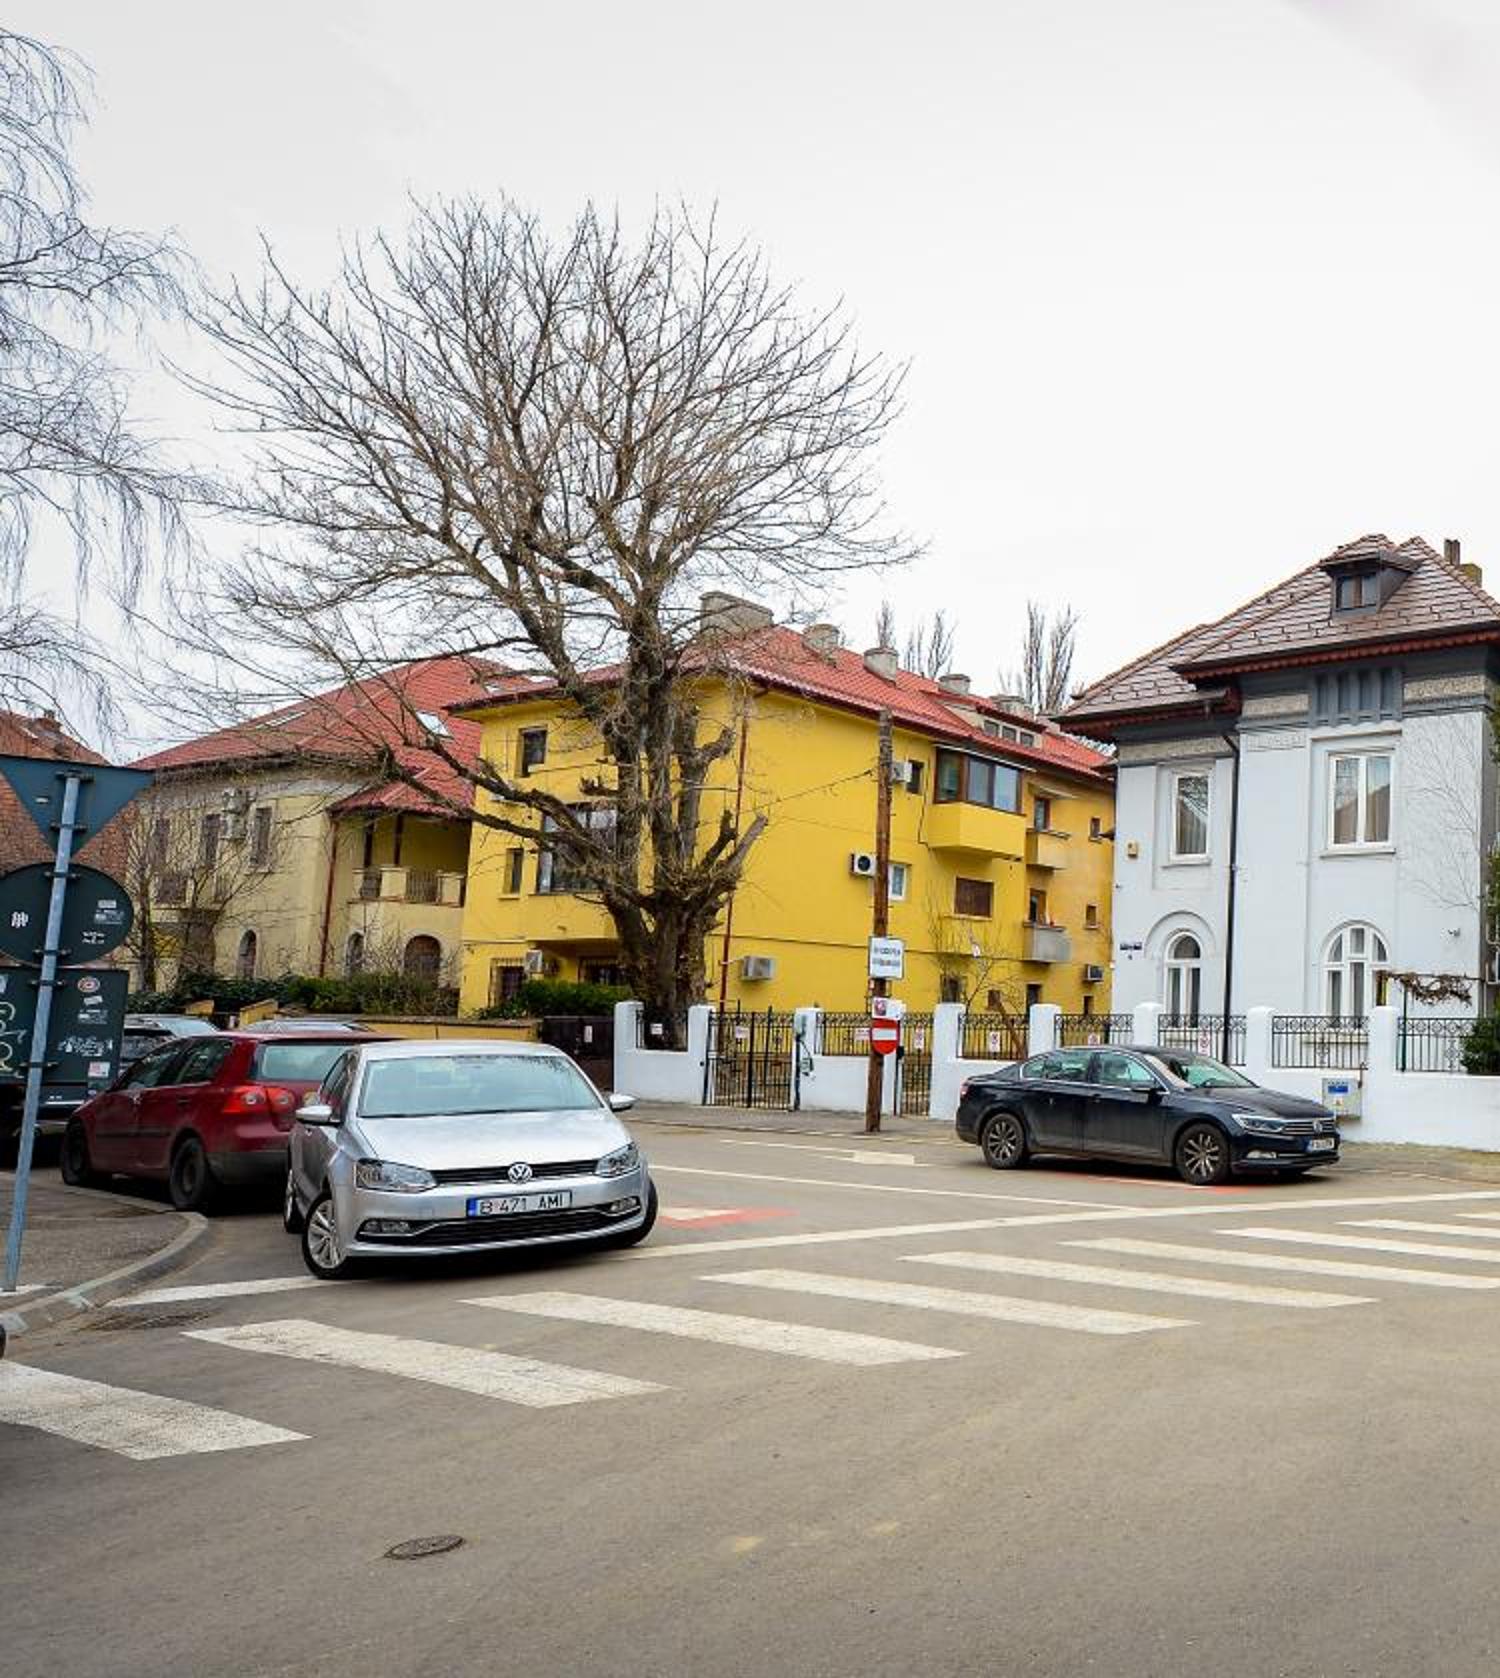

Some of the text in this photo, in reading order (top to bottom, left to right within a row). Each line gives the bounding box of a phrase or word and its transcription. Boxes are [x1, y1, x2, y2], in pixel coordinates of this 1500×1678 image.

[480, 1193, 563, 1214] B 471 AMI
